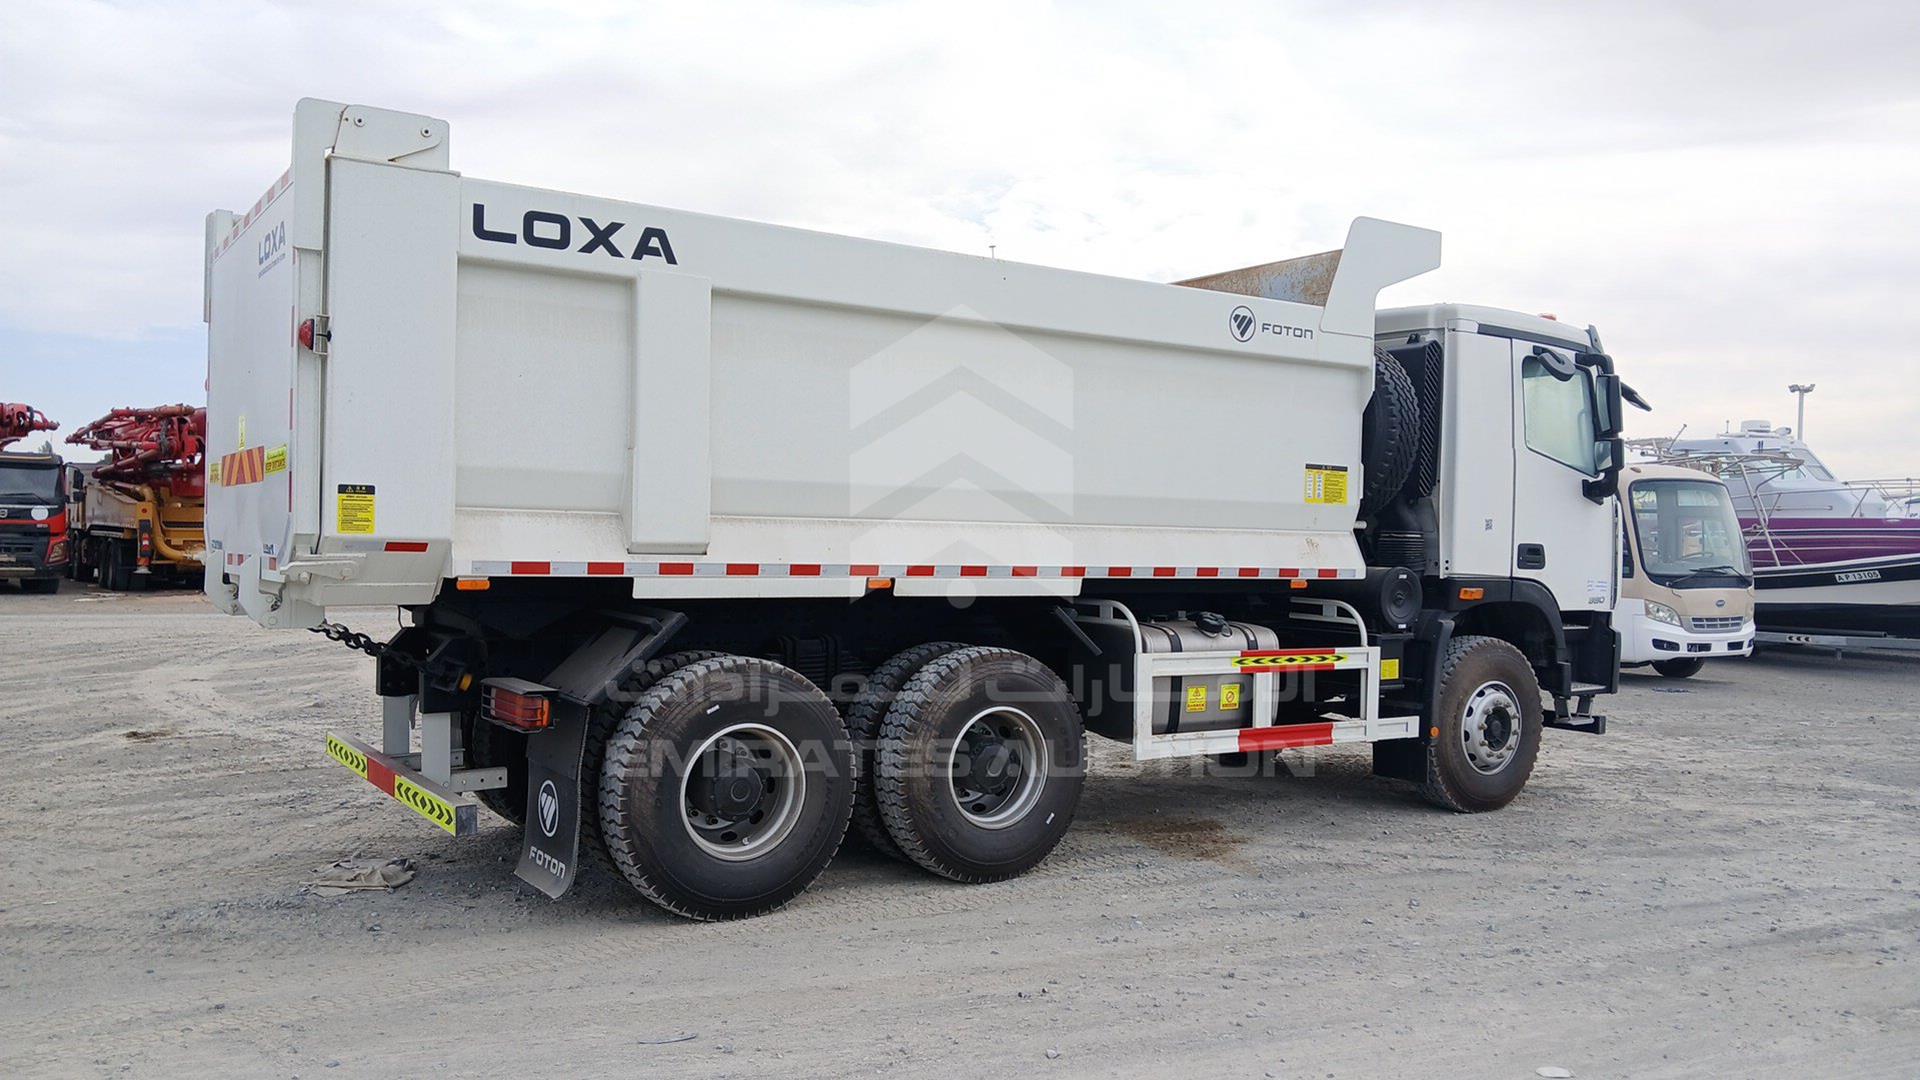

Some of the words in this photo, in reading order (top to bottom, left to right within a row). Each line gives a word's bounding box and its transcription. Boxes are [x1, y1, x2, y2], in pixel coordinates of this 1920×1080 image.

[258, 221, 286, 266] LOXA
[473, 203, 679, 266] LOXA
[1261, 322, 1314, 340] FOTON
[528, 846, 566, 879] FOTON
